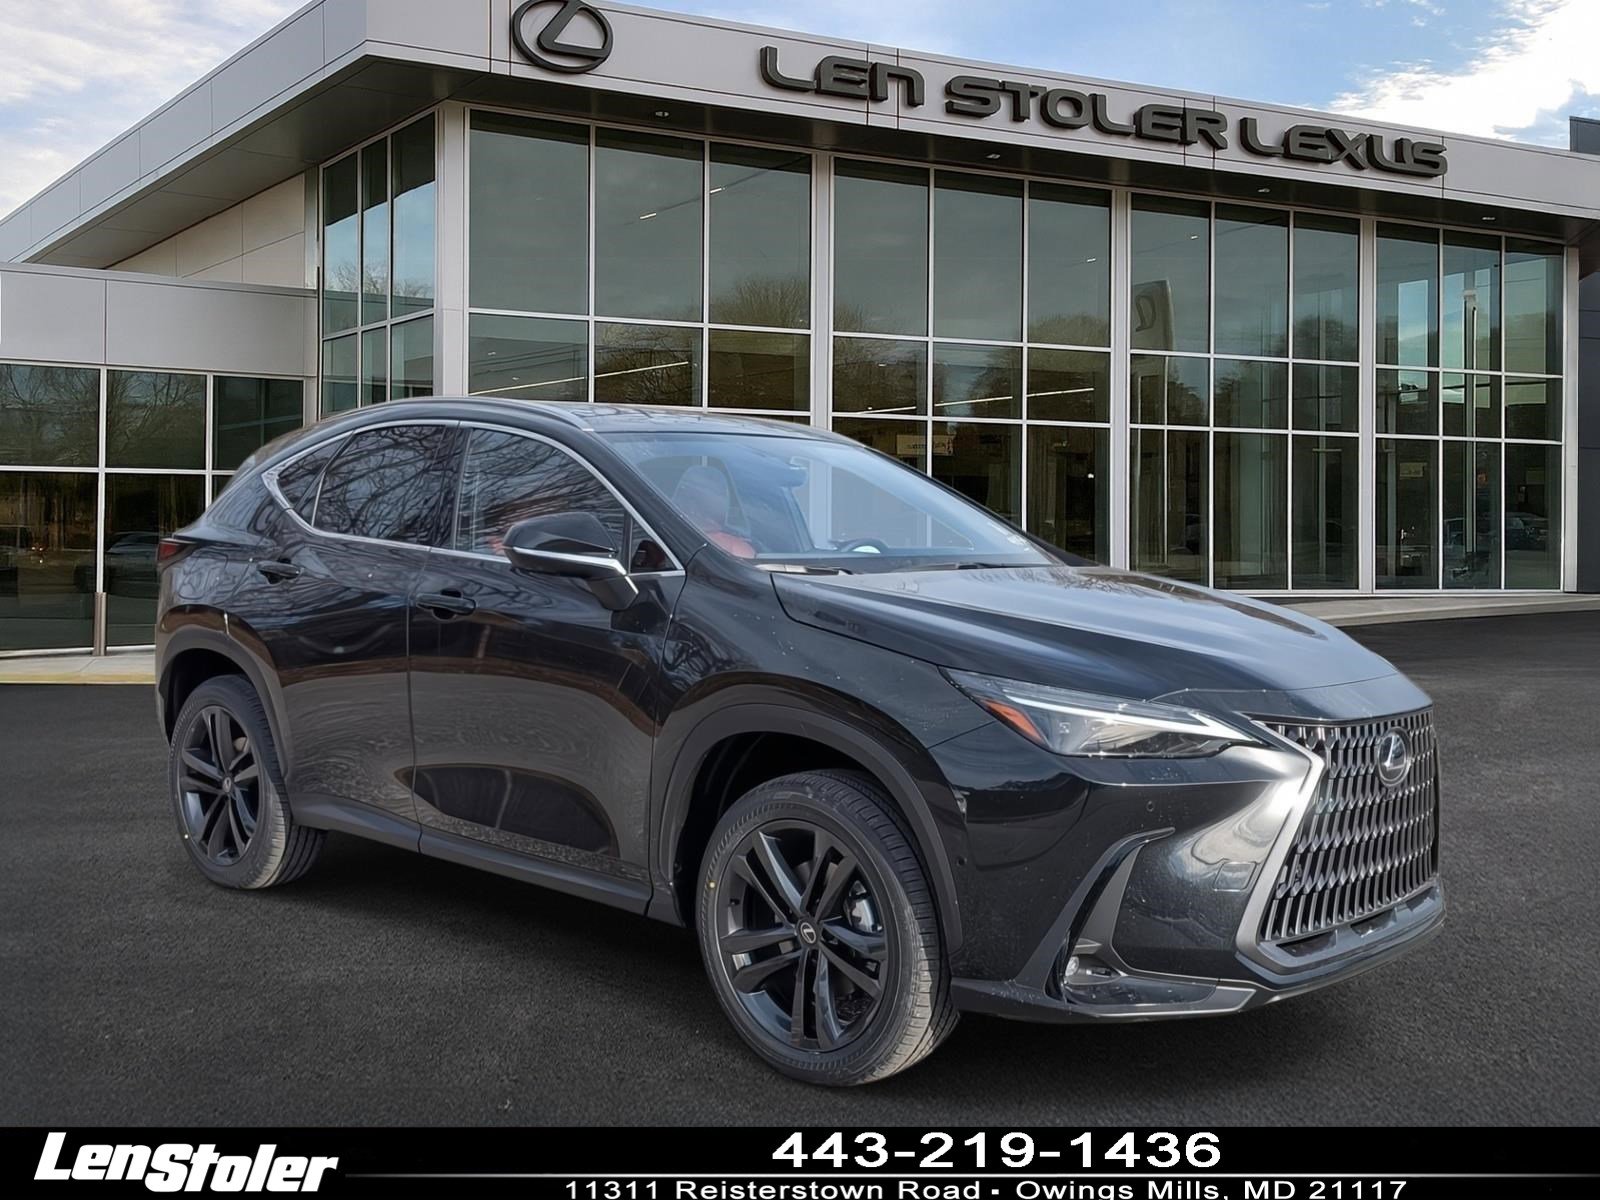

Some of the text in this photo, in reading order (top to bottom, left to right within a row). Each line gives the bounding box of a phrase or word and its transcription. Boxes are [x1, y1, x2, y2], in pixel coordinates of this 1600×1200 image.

[760, 45, 1448, 178] LEN STOLER LEXUS
